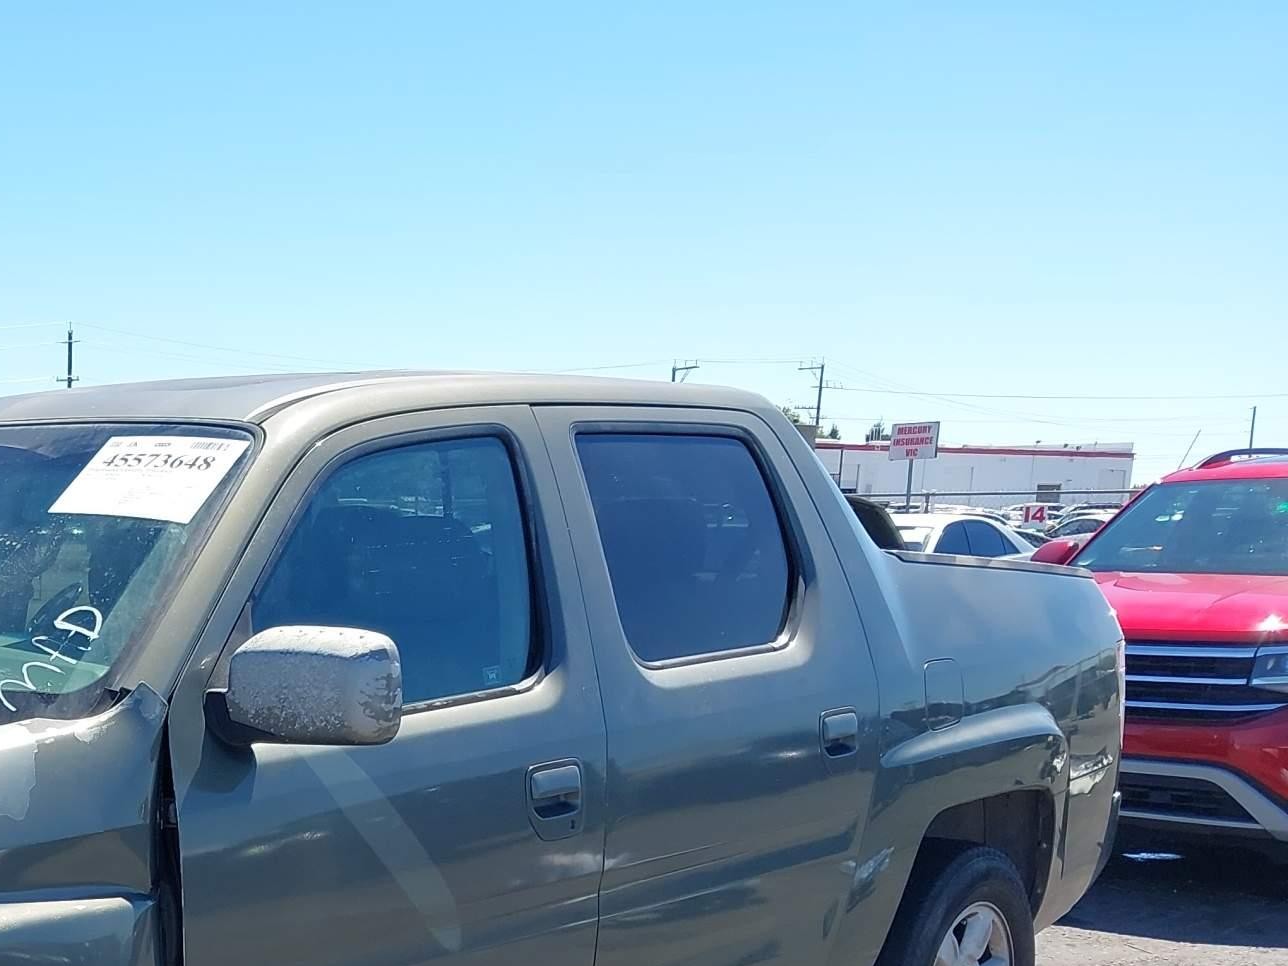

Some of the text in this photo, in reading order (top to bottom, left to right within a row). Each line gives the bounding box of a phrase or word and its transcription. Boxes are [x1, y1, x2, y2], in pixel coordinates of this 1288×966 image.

[897, 425, 932, 435] MERCURY
[893, 436, 934, 446] INSURANCE
[103, 453, 216, 471] 45573648
[1023, 506, 1045, 523] 14
